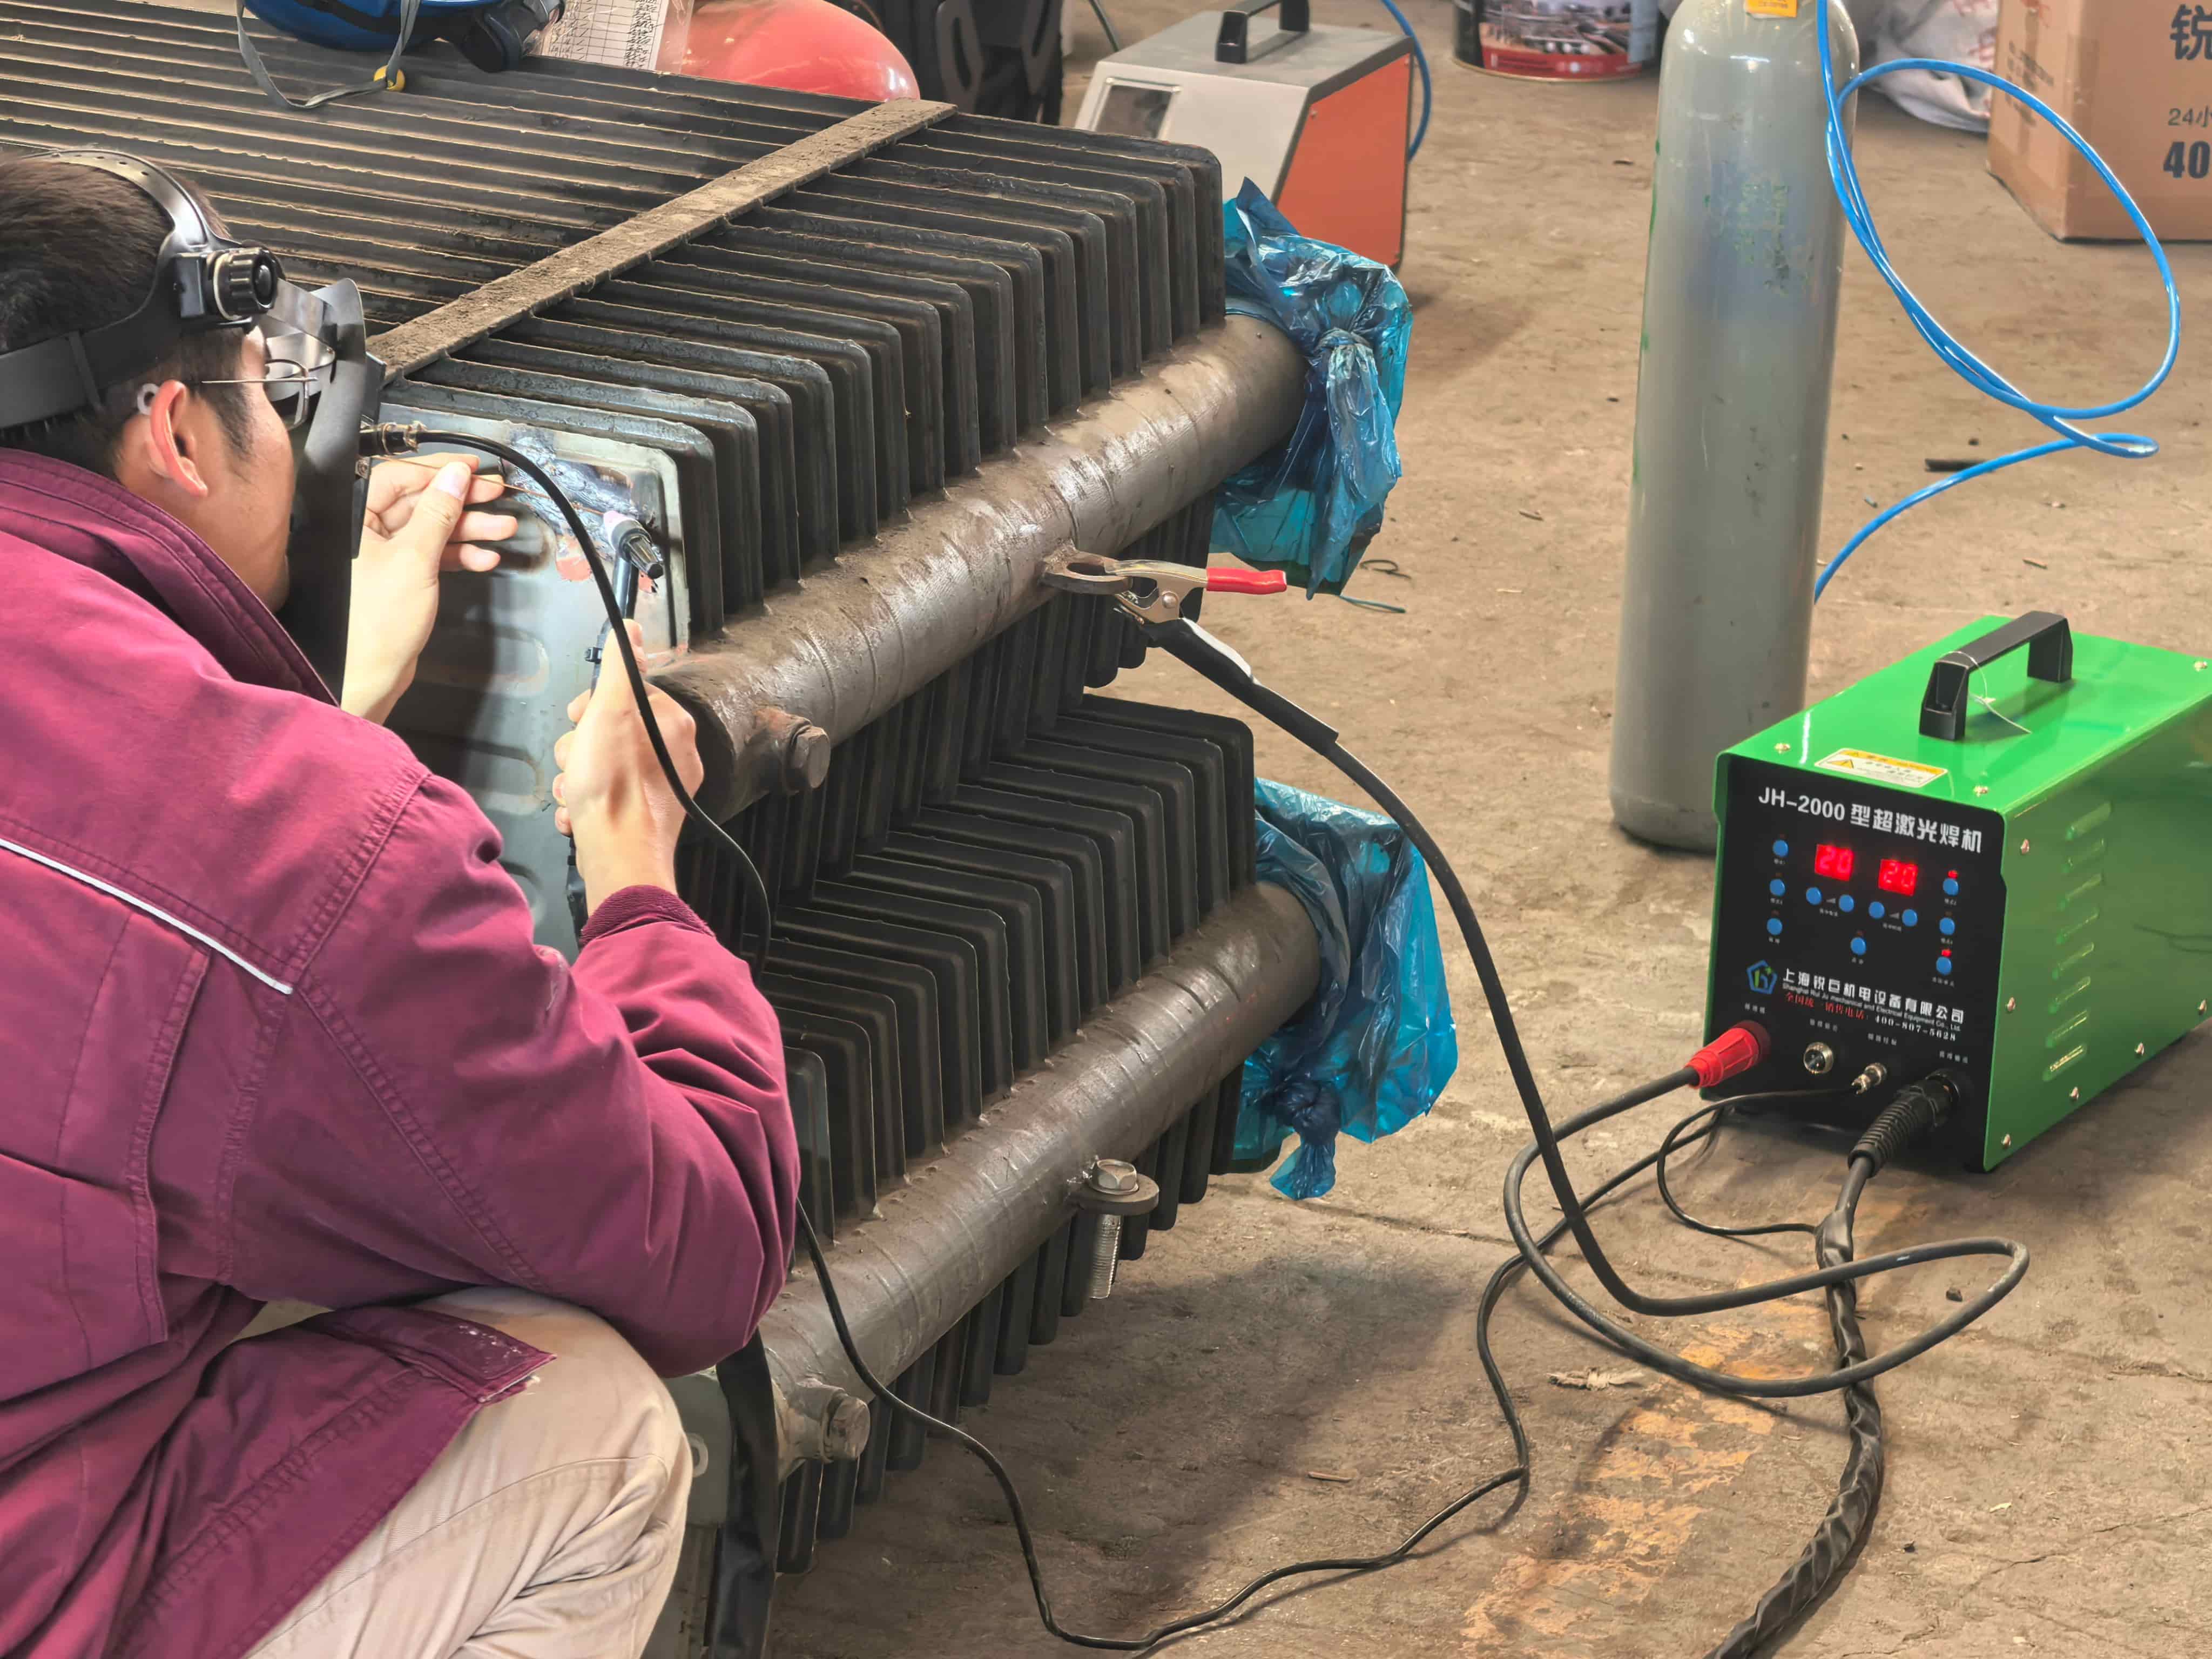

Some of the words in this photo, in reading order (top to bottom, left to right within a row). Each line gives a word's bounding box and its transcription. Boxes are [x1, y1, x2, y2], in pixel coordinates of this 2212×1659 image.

[2163, 141, 2210, 179] 40
[1758, 787, 1845, 821] JH-2000
[1850, 803, 1982, 854] 型超激光焊机
[1819, 846, 1851, 873] 20
[1883, 861, 1916, 888] 20
[1875, 1014, 1955, 1041] 400-807-5628
